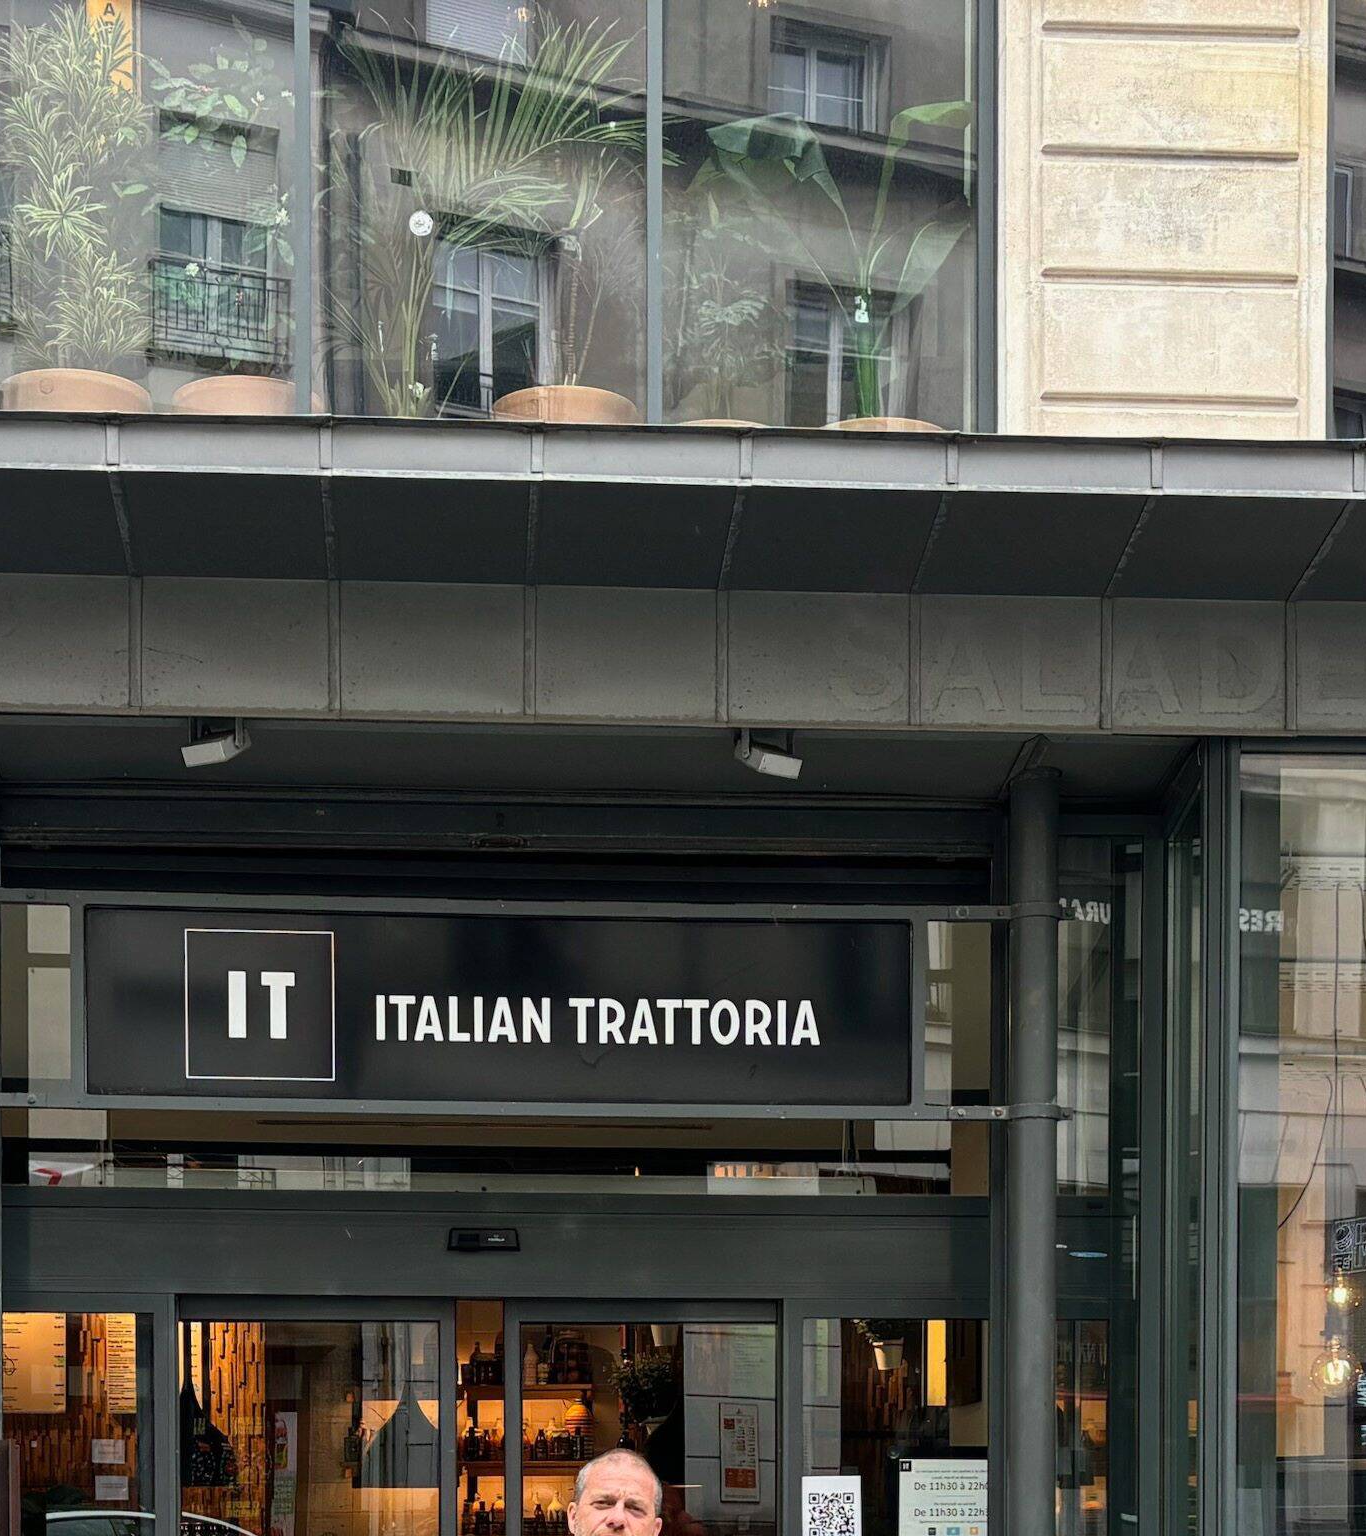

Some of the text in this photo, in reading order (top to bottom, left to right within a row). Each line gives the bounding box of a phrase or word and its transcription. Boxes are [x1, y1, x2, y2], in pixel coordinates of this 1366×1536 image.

[227, 970, 822, 1047] IT ITALIAN TRATTORIA
[914, 1482, 927, 1491] De
[929, 1481, 958, 1491] 11h30
[959, 1481, 965, 1491] à
[914, 1508, 927, 1517] De
[929, 1508, 958, 1517] 11h30
[959, 1508, 965, 1517] à
